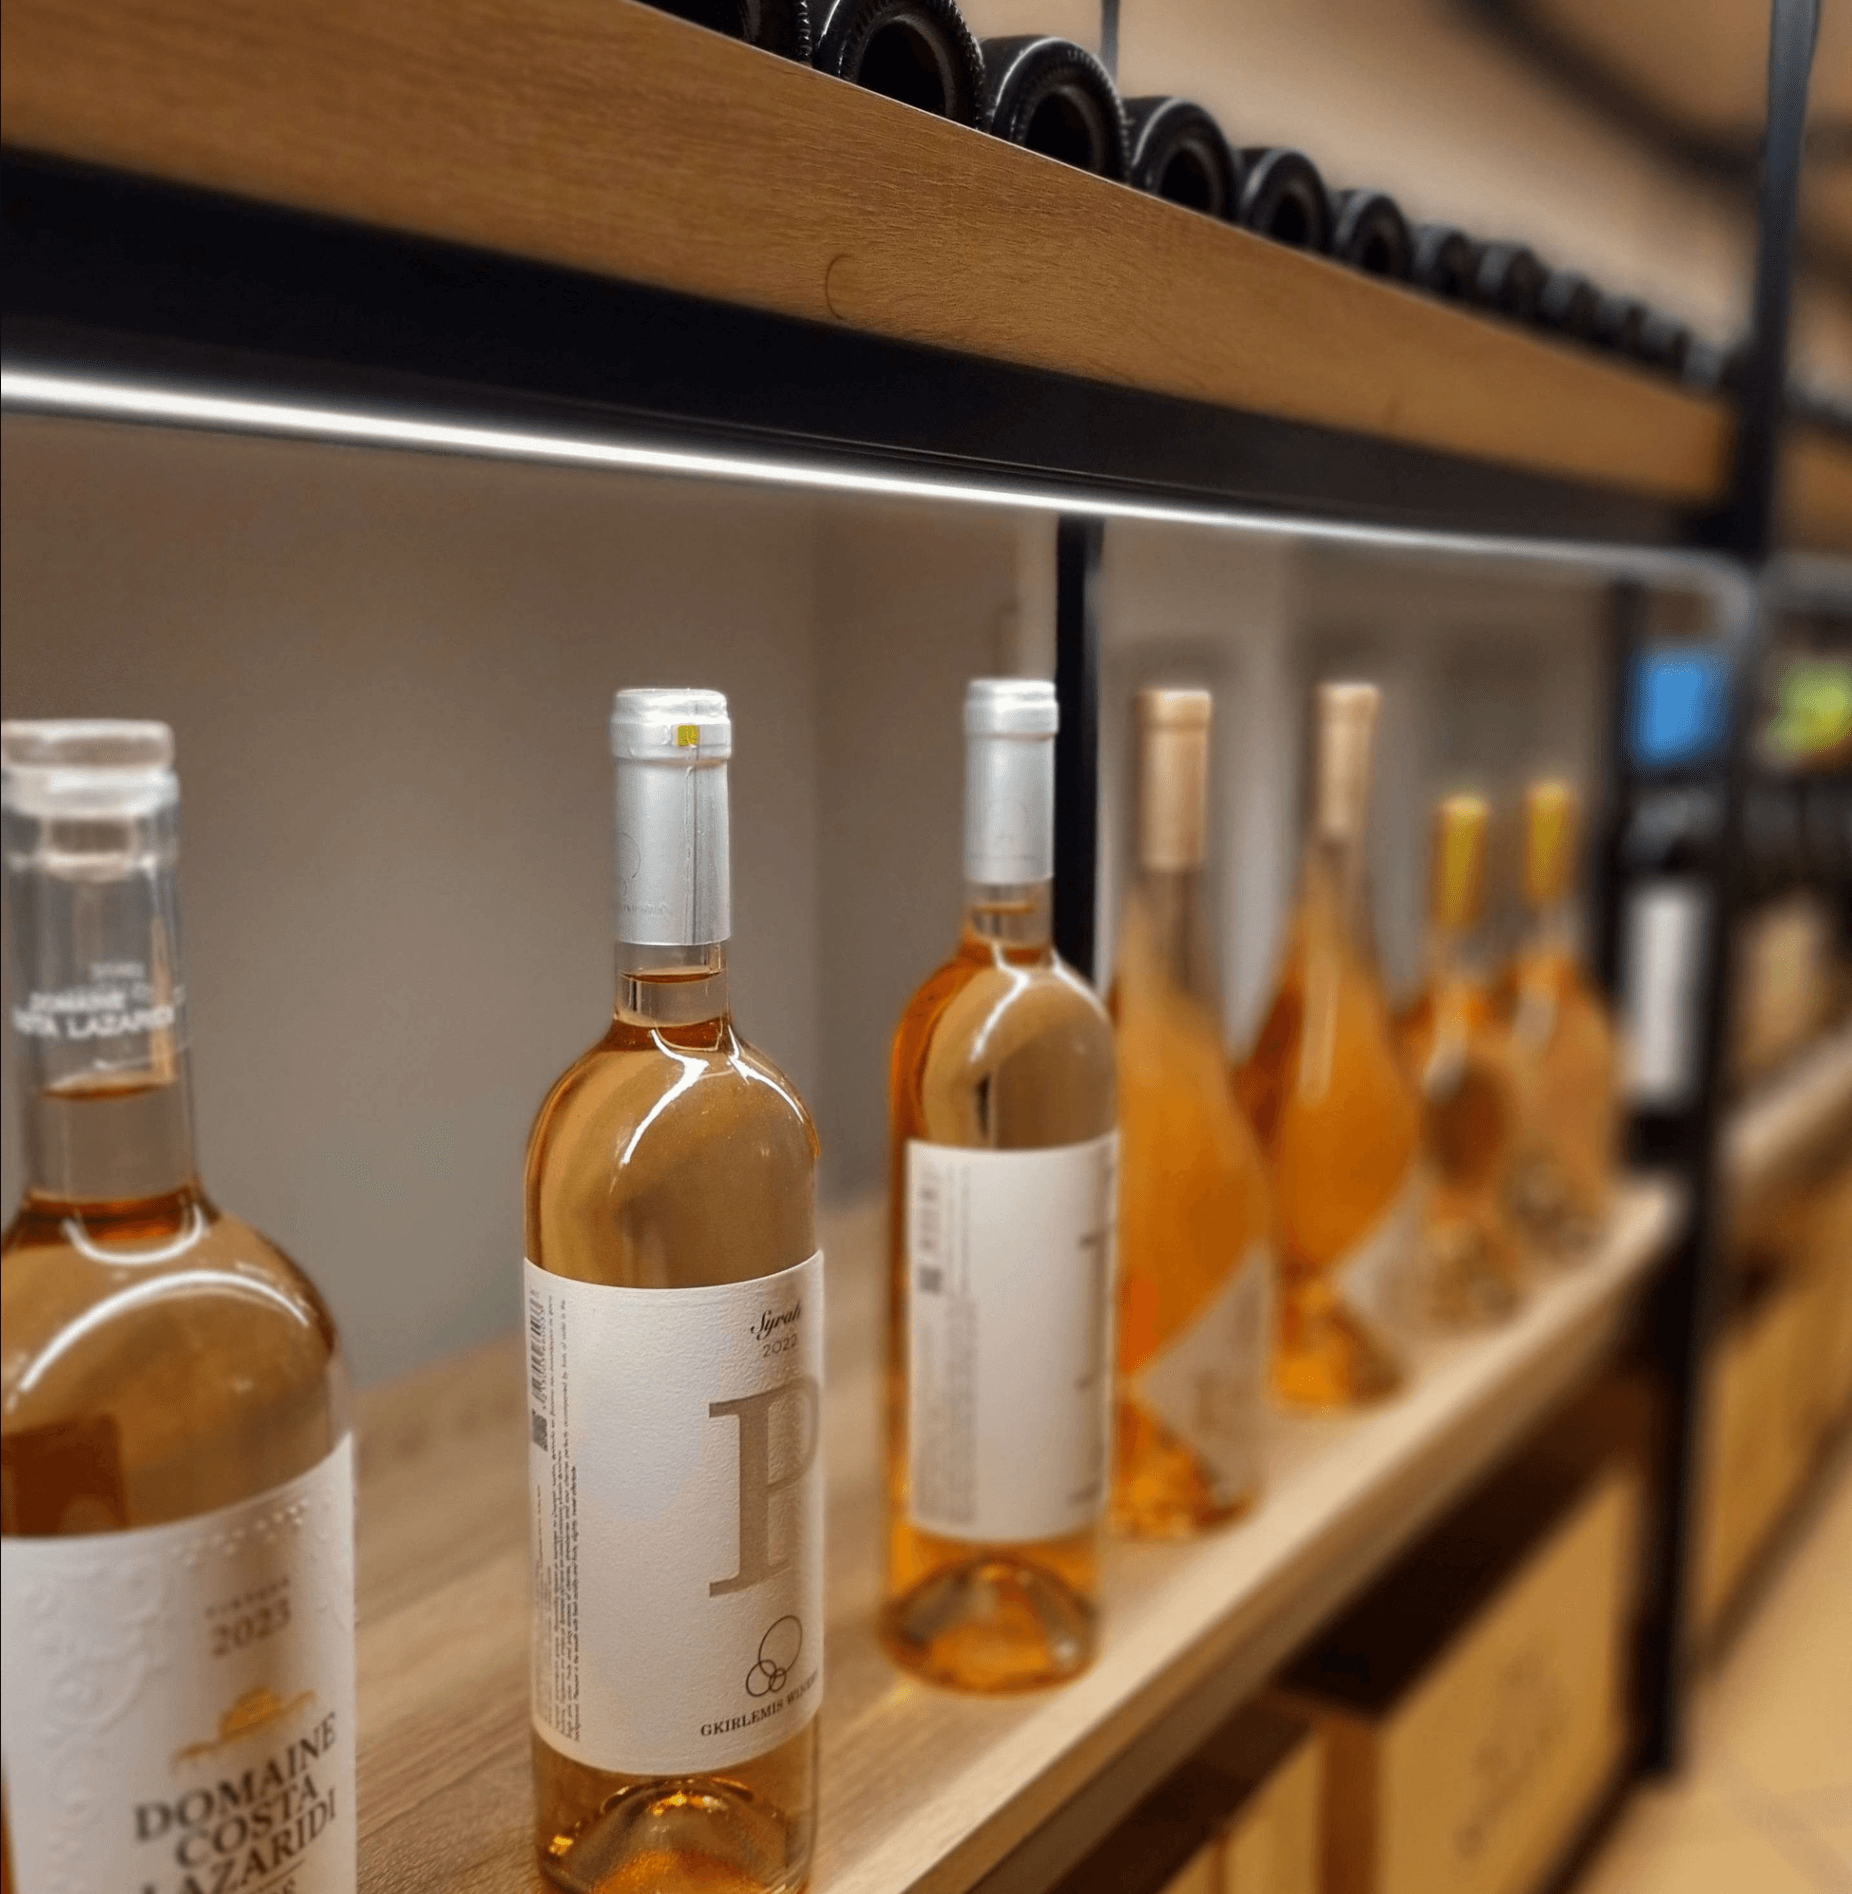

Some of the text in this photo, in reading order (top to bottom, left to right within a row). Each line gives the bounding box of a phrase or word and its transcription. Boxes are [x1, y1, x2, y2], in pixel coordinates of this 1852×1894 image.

[750, 1300, 802, 1341] Syrah
[762, 1333, 798, 1358] 2022
[709, 1374, 820, 1597] P
[210, 1597, 292, 1659] 2023
[700, 1697, 784, 1737] GKIRLEMIS
[134, 1712, 337, 1844] DOMAINE
[175, 1774, 319, 1869] COSTA
